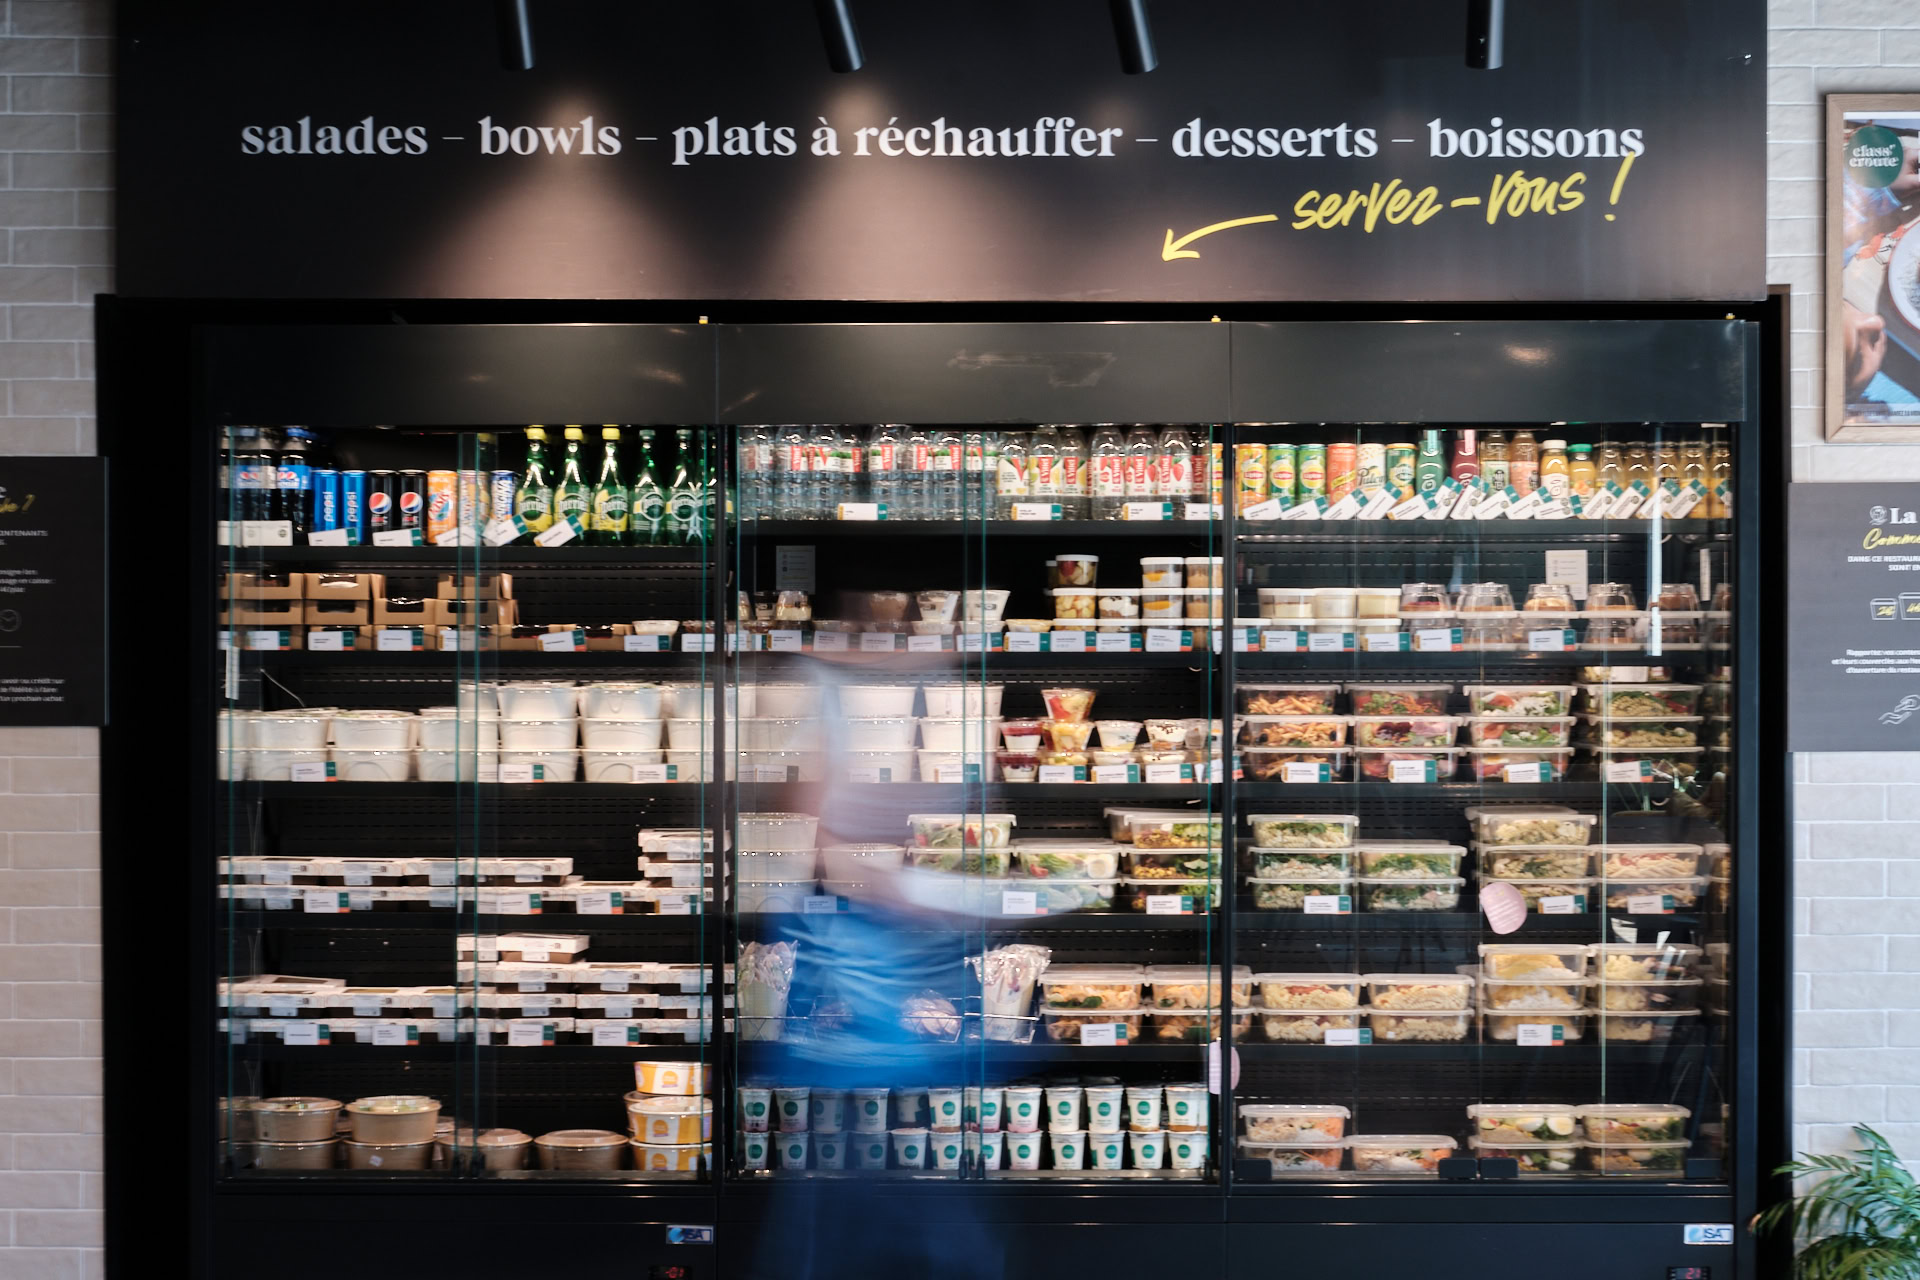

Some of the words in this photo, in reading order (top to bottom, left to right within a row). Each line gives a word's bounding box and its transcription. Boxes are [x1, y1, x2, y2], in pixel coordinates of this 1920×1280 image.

[241, 115, 428, 155] salades
[478, 115, 621, 155] bowls
[672, 116, 797, 165] plats
[811, 116, 841, 156] à
[853, 116, 1123, 157] réchauffer
[1172, 118, 1379, 157] desserts
[1427, 117, 1645, 158] boissons
[322, 491, 335, 522] pepsi
[346, 491, 359, 522] pepsi
[1889, 507, 1918, 525] La
